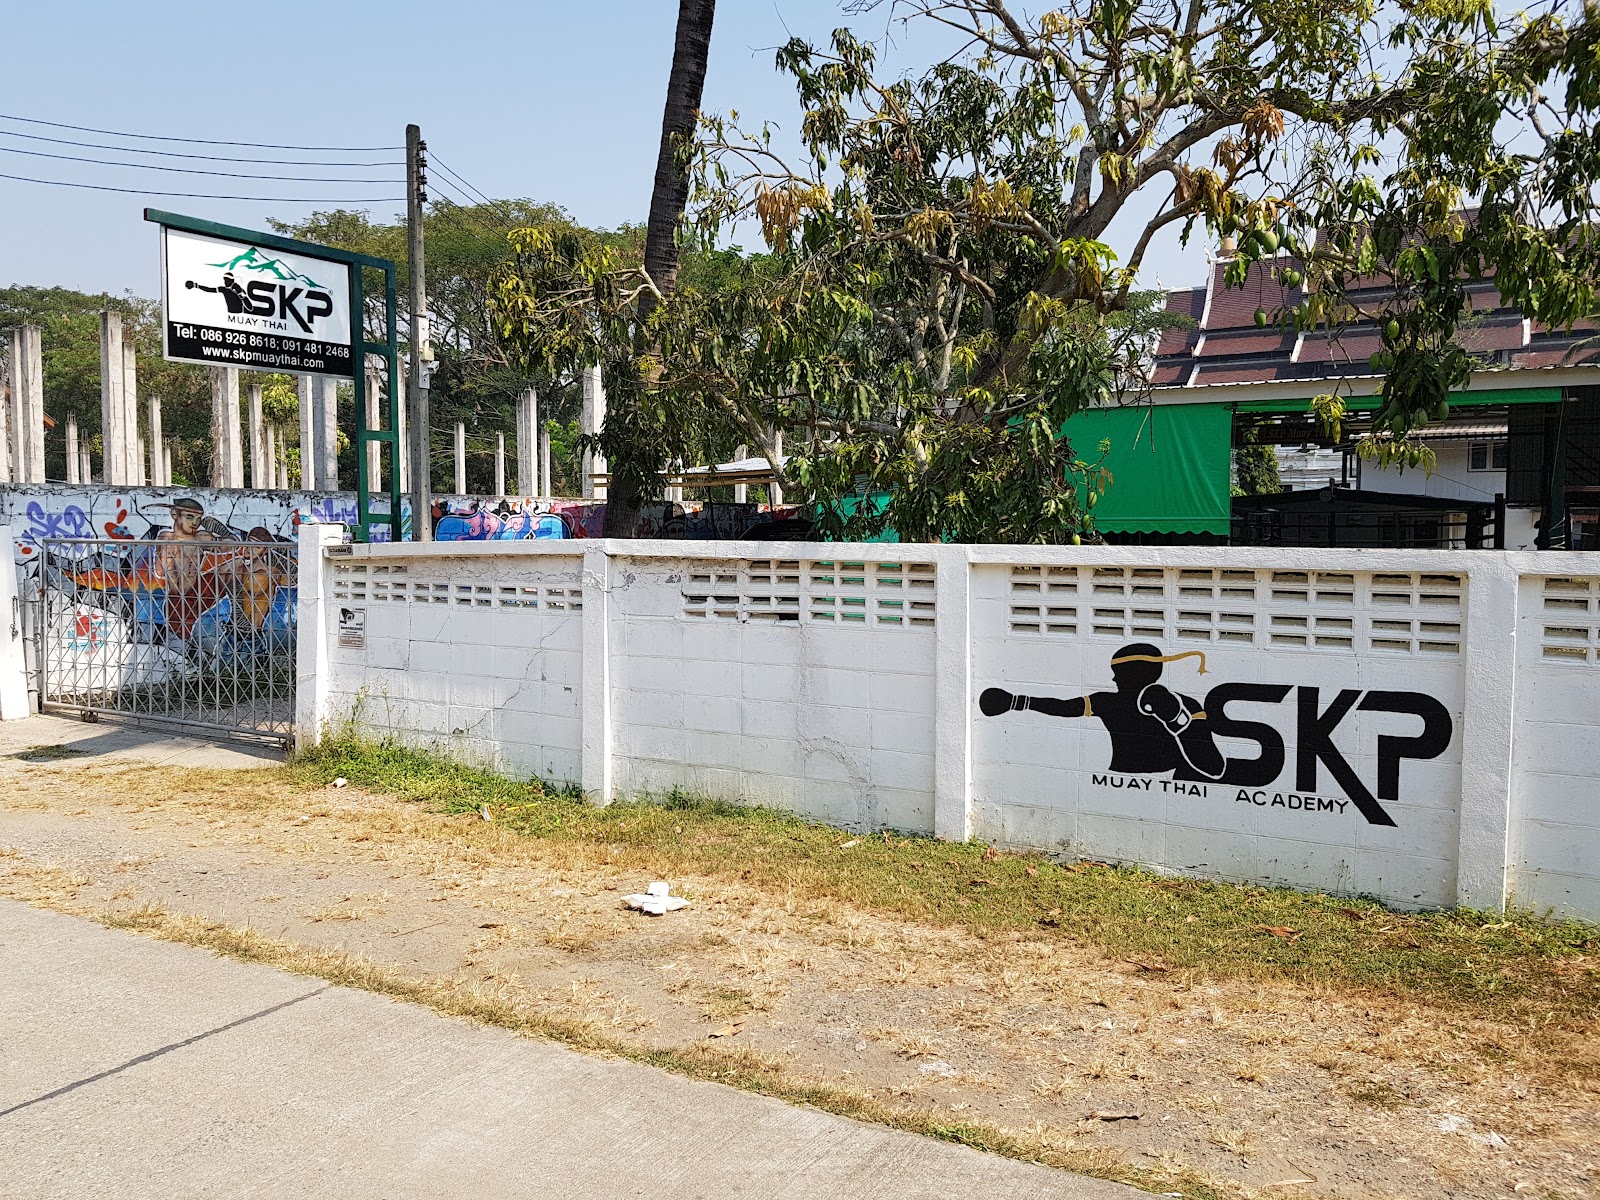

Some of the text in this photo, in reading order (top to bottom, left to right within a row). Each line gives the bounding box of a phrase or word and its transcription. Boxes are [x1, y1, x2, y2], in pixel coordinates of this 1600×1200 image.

[227, 315, 287, 331] MUAY THAI
[247, 280, 333, 334] SKP
[173, 323, 350, 358] Tel: 086 926 8618; 091 481 2468
[202, 346, 325, 369] www.skpmuaythai.com
[26, 501, 90, 539] SKP
[1203, 682, 1453, 828] SKP
[1092, 774, 1349, 814] MUAY THAI ACADEMY
